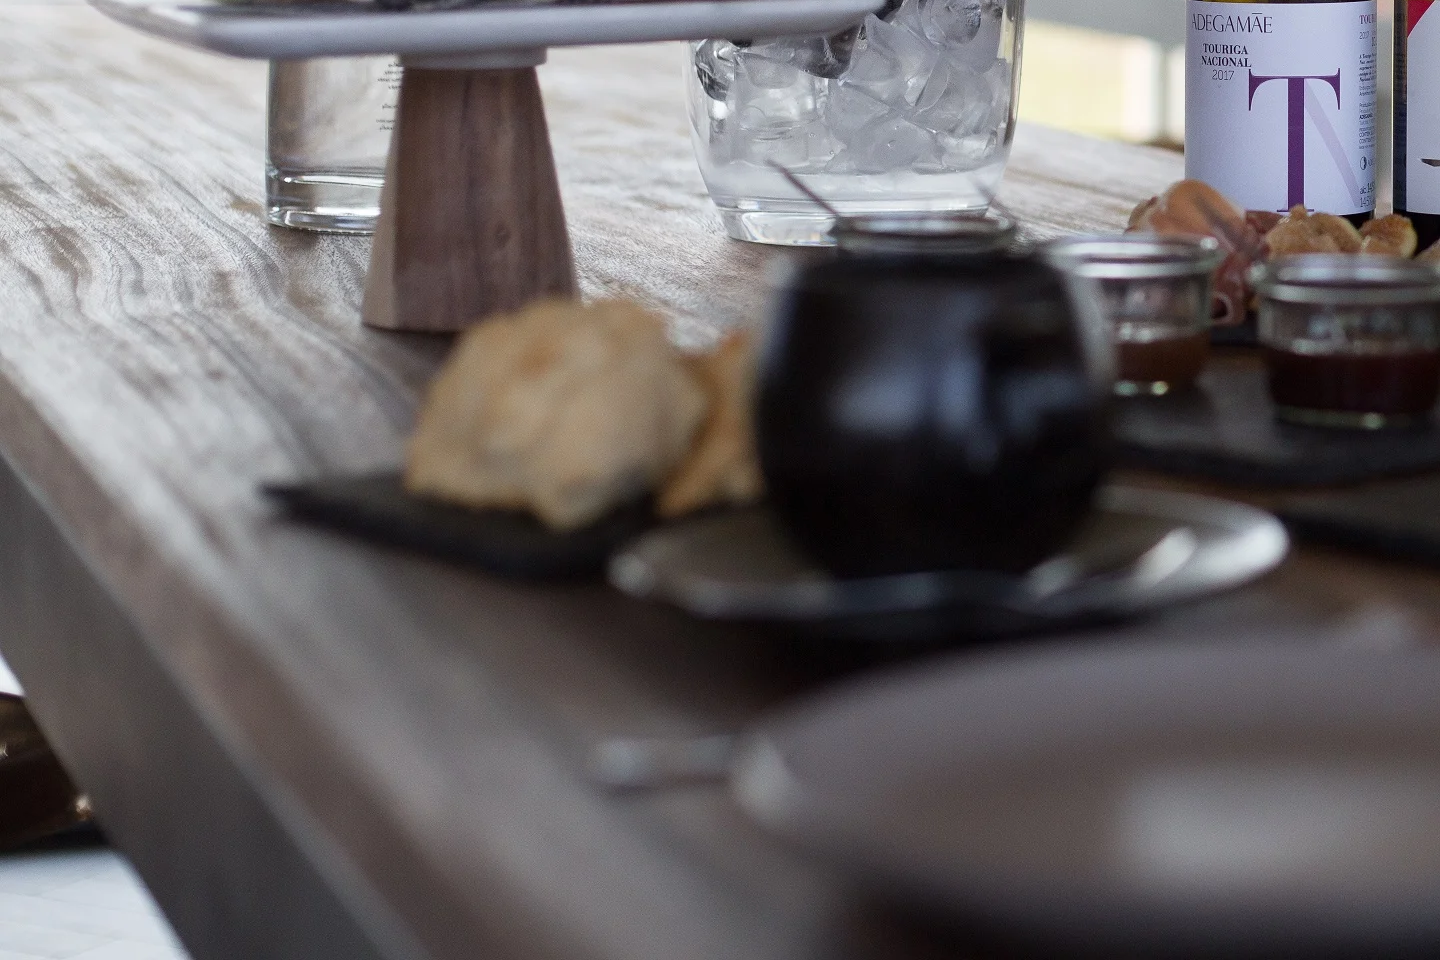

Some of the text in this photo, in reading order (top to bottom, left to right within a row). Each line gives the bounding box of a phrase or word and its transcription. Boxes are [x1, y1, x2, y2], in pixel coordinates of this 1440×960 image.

[1203, 42, 1249, 55] TOURIGA
[1201, 55, 1252, 68] NACIONAL
[1211, 69, 1235, 81] 2017
